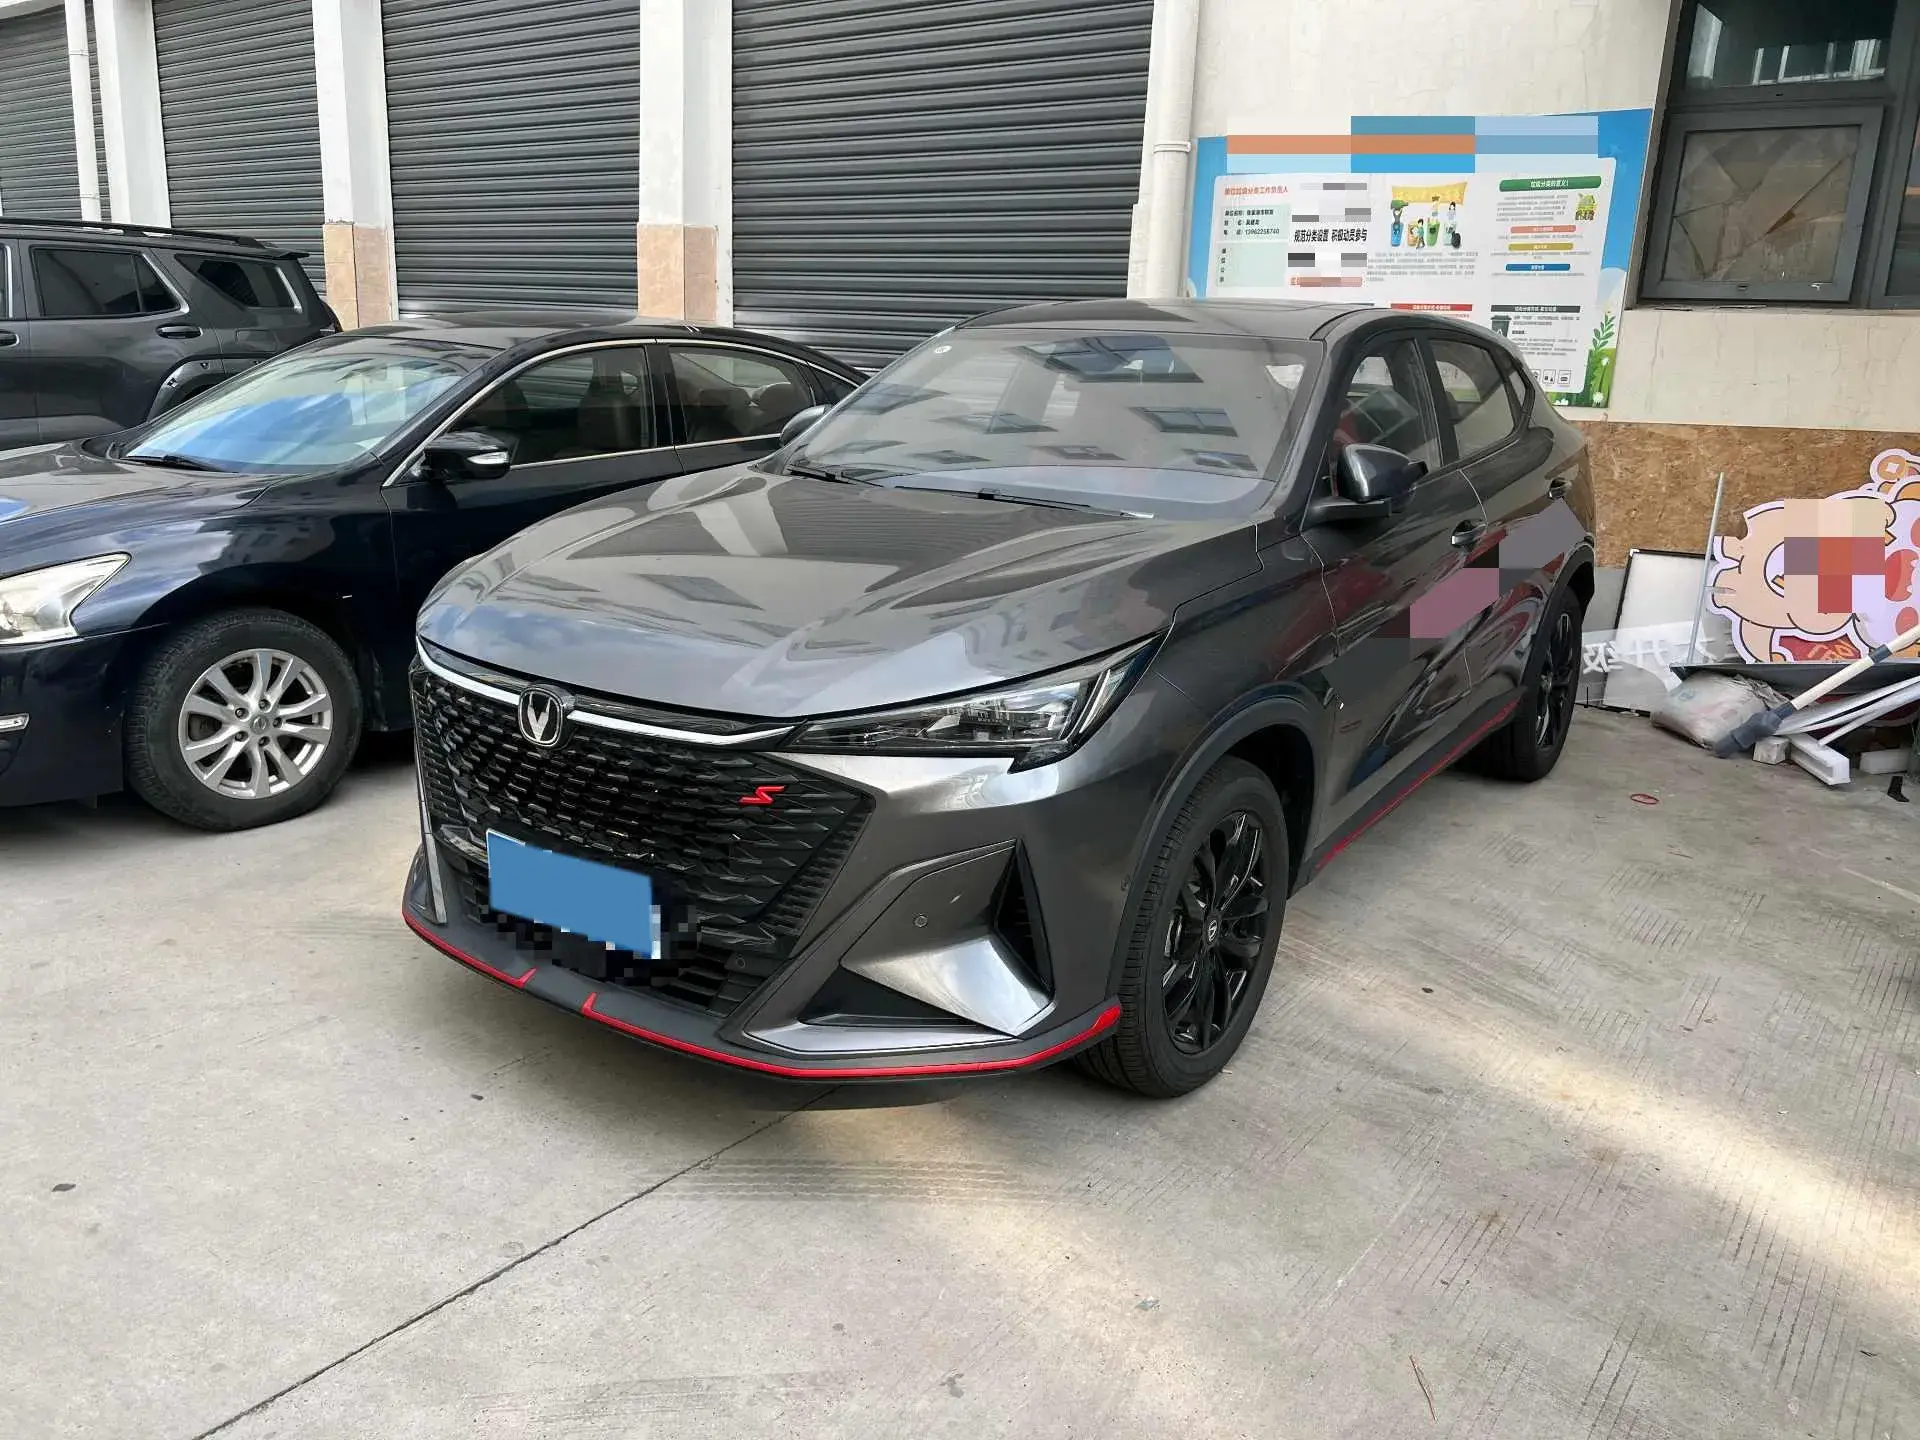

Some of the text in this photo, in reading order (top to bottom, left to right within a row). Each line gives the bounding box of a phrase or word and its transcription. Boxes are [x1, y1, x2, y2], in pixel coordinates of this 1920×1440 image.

[1293, 228, 1368, 243] 规范分类设置 积极动员参与
